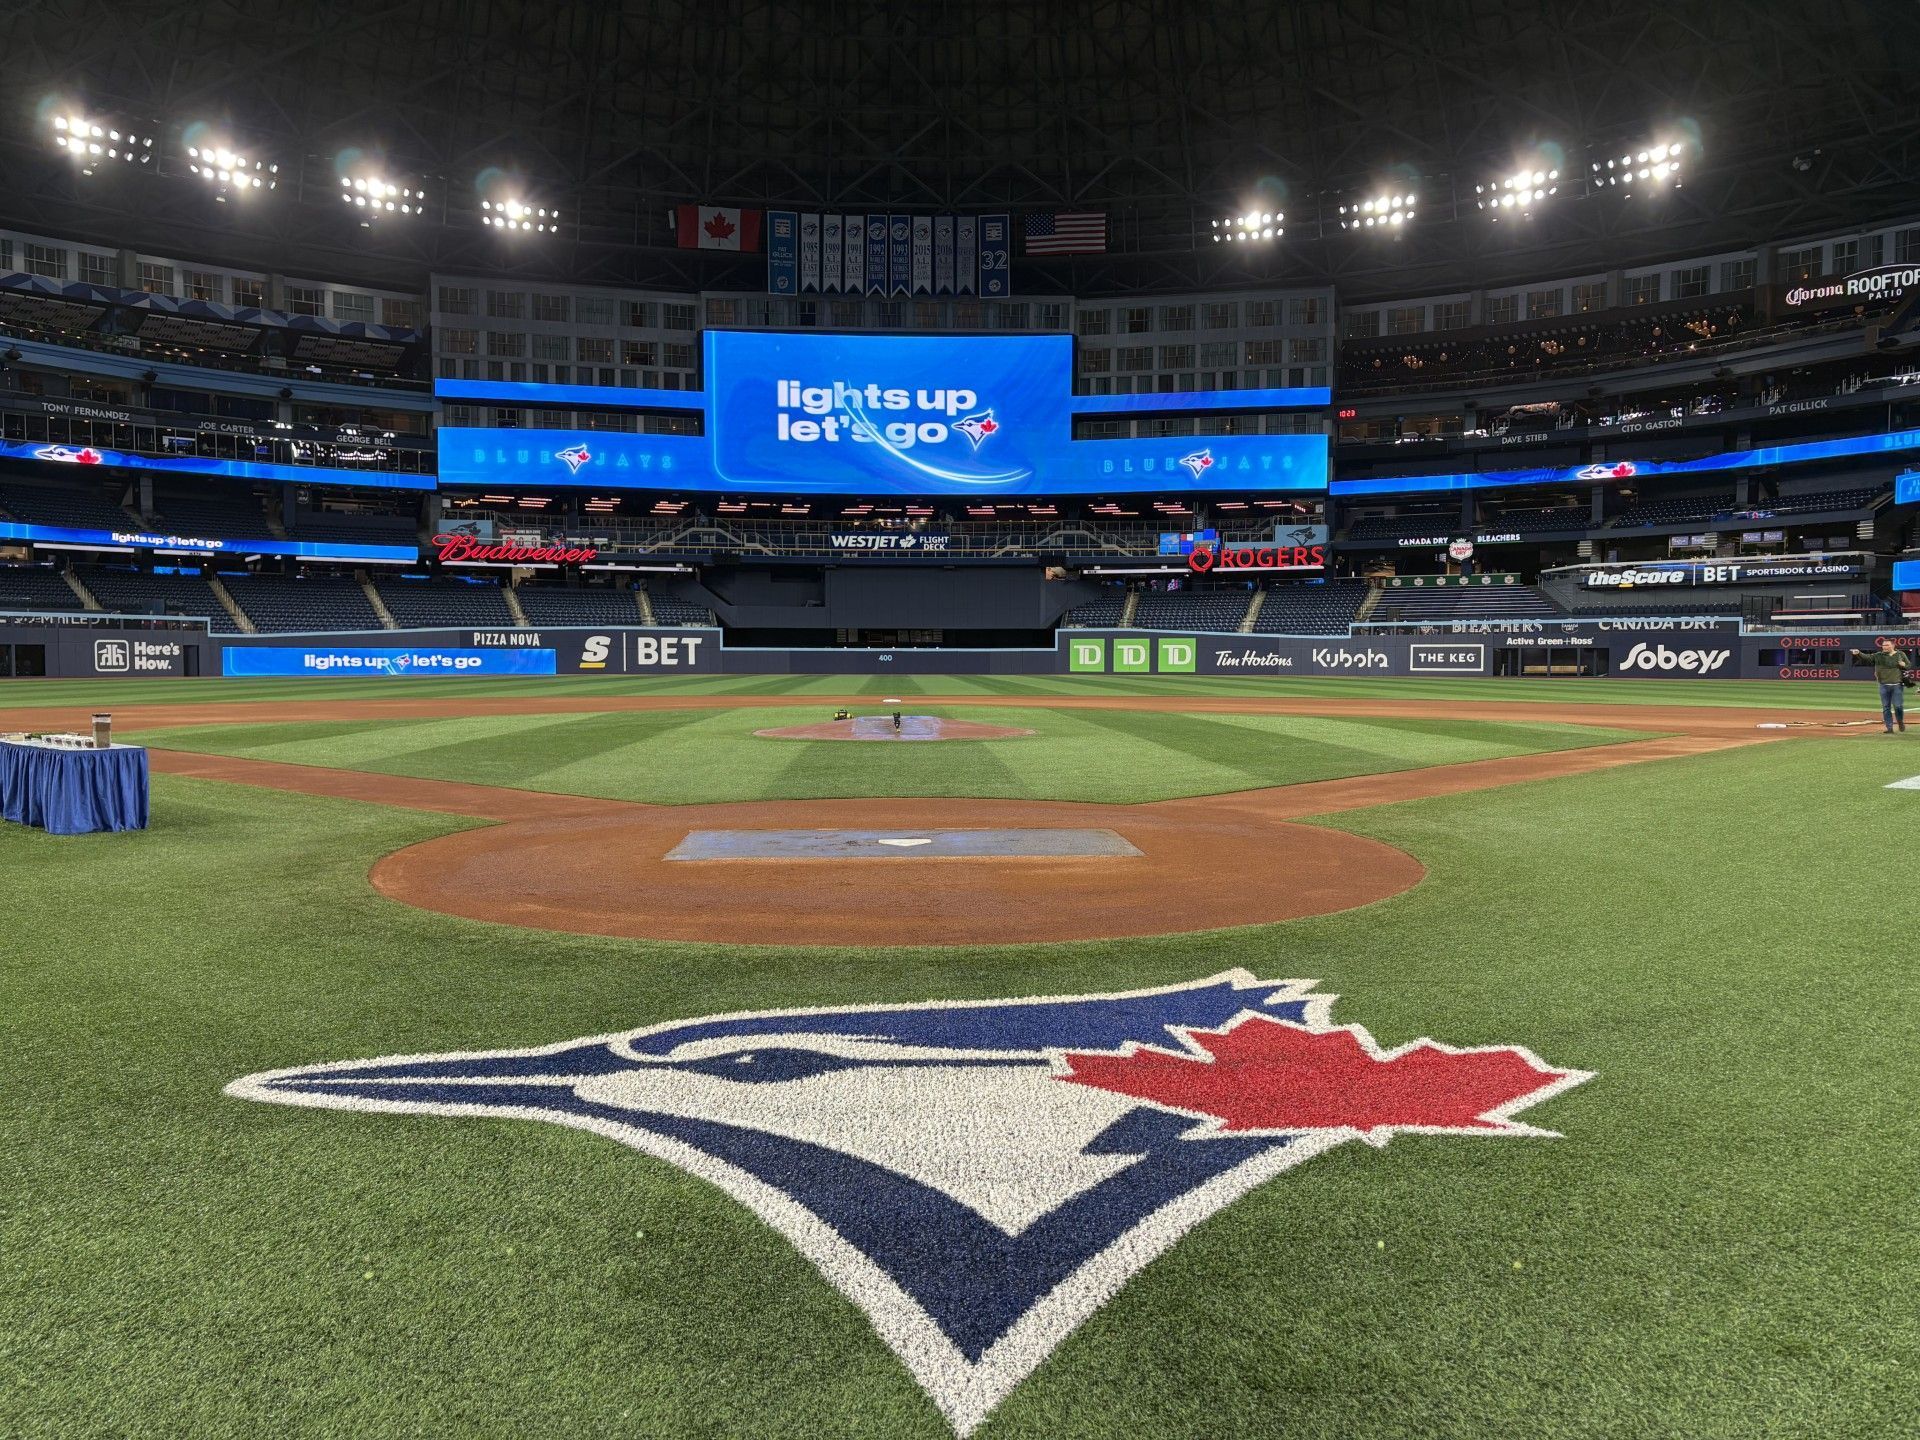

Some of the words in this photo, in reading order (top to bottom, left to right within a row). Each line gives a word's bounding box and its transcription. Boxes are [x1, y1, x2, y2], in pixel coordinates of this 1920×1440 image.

[981, 250, 1007, 270] 32
[1785, 284, 1844, 306] Corona
[1868, 288, 1903, 300] PATIO
[777, 380, 909, 415] lights
[916, 388, 977, 416] up
[42, 402, 70, 414] TONY
[74, 406, 130, 421] FERNANDEZ
[1769, 404, 1788, 415] PAT
[1789, 399, 1828, 412] GILLICK
[198, 421, 216, 430] JOE
[220, 424, 254, 434] CARTER
[777, 413, 879, 443] let's
[885, 422, 948, 449] go
[1621, 423, 1642, 433] CITO
[1645, 418, 1683, 431] GASTON
[336, 434, 370, 445] GEORGE
[374, 438, 392, 446] BELL
[1502, 435, 1522, 445] DAVE
[1525, 433, 1548, 443] STIEB
[474, 449, 550, 464] BLUE
[596, 453, 672, 468] JAYS
[1104, 457, 1174, 472] BLUE
[1217, 455, 1293, 470] JAYS
[148, 536, 164, 545] up
[206, 540, 223, 548] go
[831, 535, 899, 550] WESTJET
[919, 536, 949, 544] FLIGHT
[1398, 537, 1432, 546] CANADA
[1432, 536, 1449, 545] DRY
[1477, 533, 1521, 543] BLEACHERS
[431, 534, 597, 562] Budweiser
[923, 543, 945, 551] DECK
[1219, 546, 1325, 568] ROGERS
[1588, 569, 1685, 586] theScore
[1703, 565, 1742, 583] BET
[1746, 567, 1804, 576] SPORTSBOOK
[1815, 565, 1849, 573] CASINO
[473, 632, 507, 646] PIZZA
[510, 633, 541, 647] NOVA
[1506, 637, 1534, 646] Active
[1794, 637, 1841, 647] ROGERS
[134, 641, 180, 656] Here's
[581, 635, 611, 662] S
[637, 636, 702, 665] BET
[1074, 645, 1101, 665] TD
[1117, 645, 1146, 665] TD
[1162, 645, 1192, 665] TD
[134, 656, 172, 670] How.
[304, 654, 363, 670] lights
[364, 657, 390, 669] up
[412, 654, 453, 667] let's
[454, 657, 482, 669] go
[879, 654, 893, 662] 400
[1215, 650, 1240, 667] Tim
[1241, 649, 1293, 668] Hortons
[1312, 648, 1389, 668] Kubota
[1419, 653, 1444, 662] THE
[1449, 653, 1476, 662] KEG
[1619, 642, 1730, 674] Sobeys
[1793, 669, 1840, 678] ROGERS
